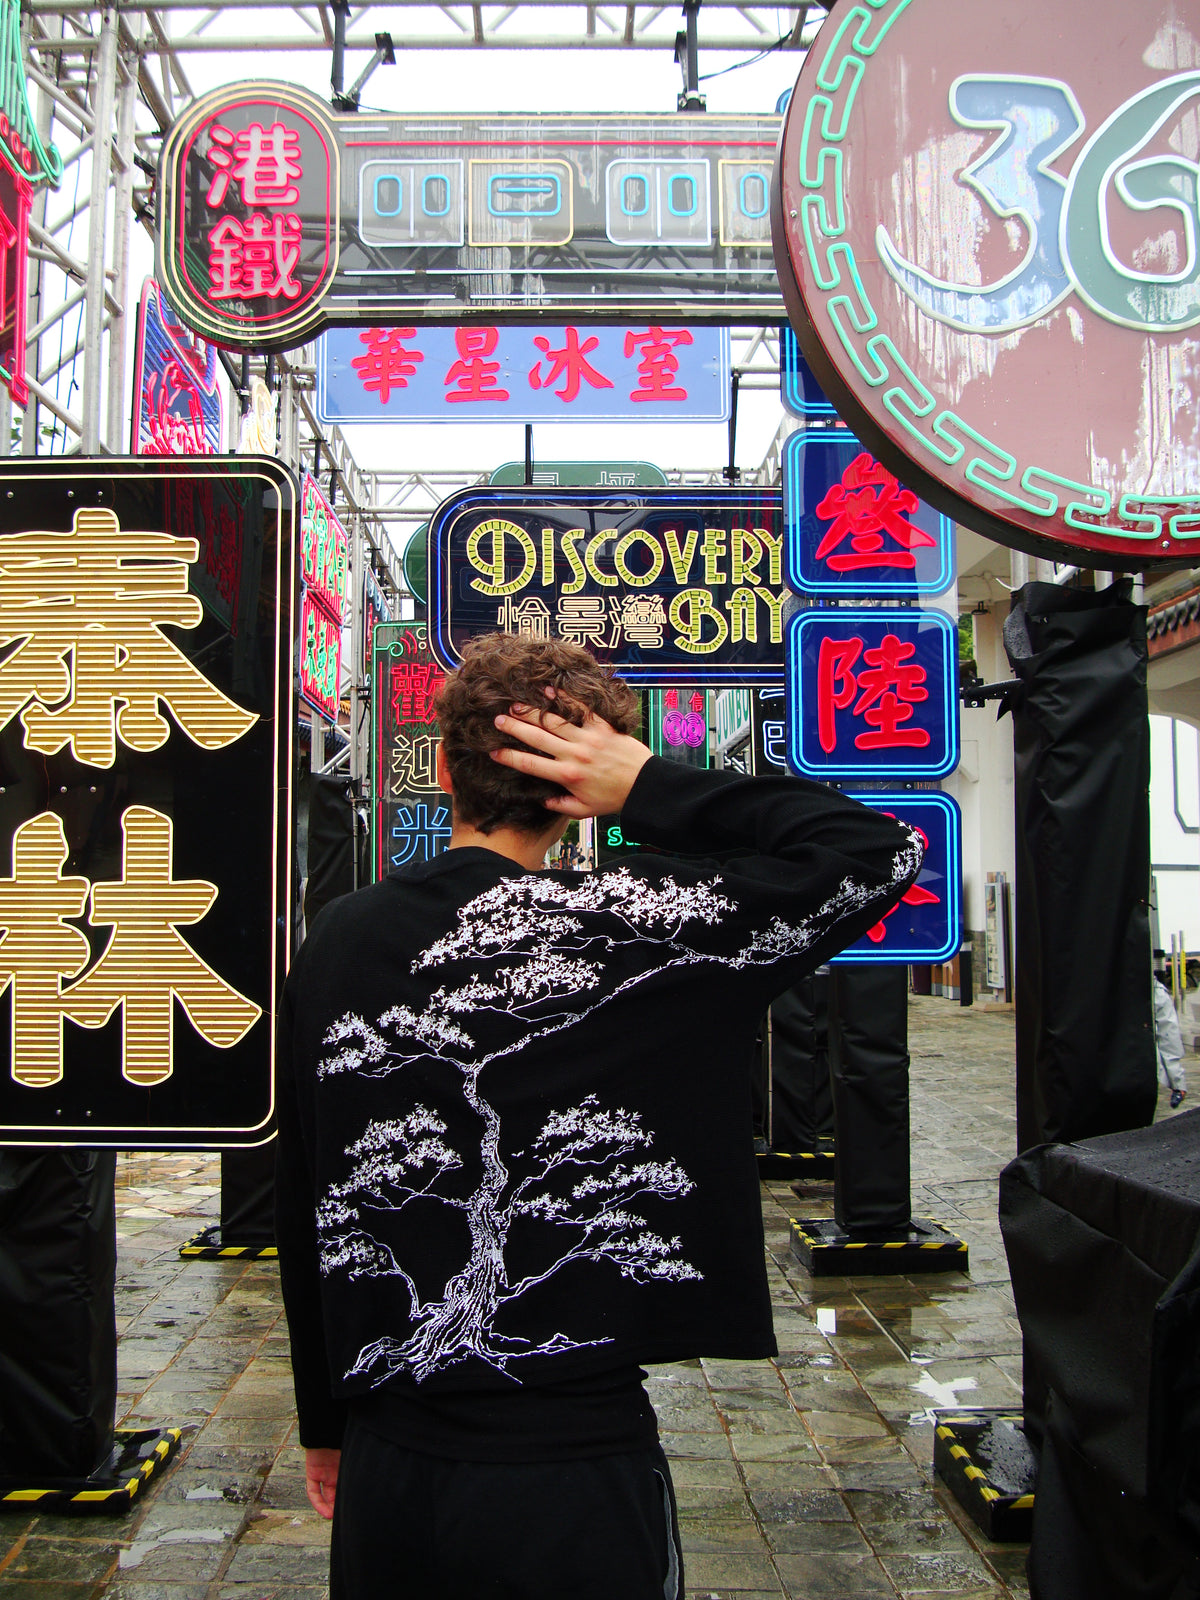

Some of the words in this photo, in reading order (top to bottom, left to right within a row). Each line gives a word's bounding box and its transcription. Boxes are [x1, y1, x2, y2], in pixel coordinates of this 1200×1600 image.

[207, 122, 303, 300] 港鐵
[875, 70, 1200, 333] 36
[350, 326, 694, 404] 華星冰室
[466, 518, 784, 596] DISCOVERY
[497, 595, 668, 649] 愉景灣
[668, 587, 792, 654] BAY
[717, 689, 750, 745] JUMBO
